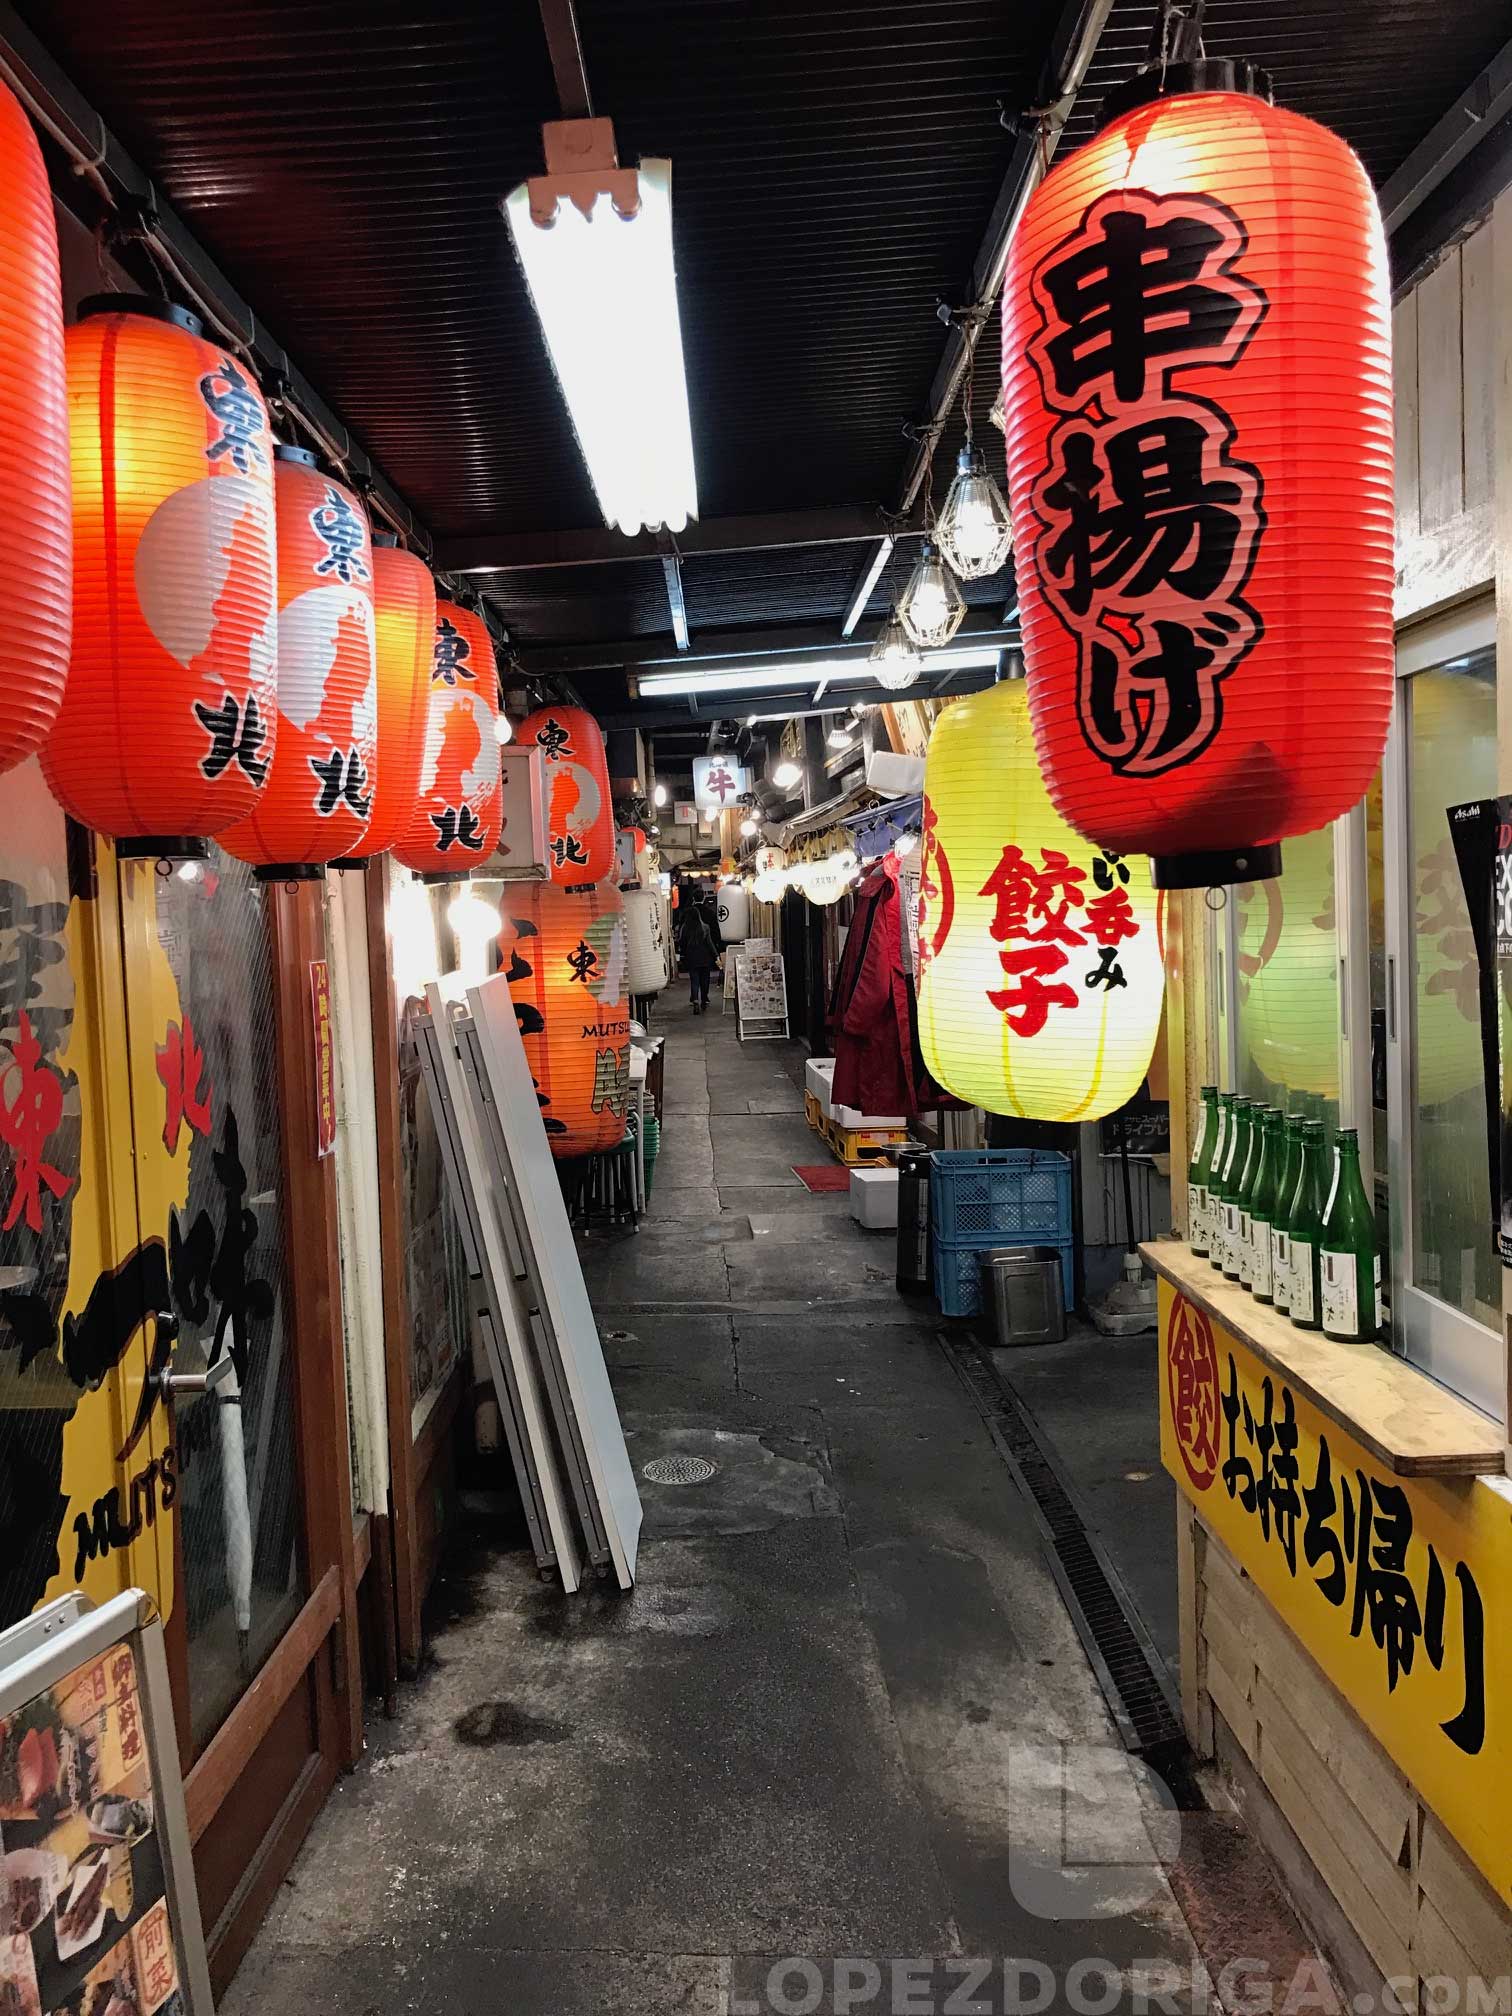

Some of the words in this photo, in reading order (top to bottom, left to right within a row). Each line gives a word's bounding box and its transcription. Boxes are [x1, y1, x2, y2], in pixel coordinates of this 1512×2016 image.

[1036, 203, 1258, 768] 串揚げ
[432, 617, 479, 685] 東
[536, 719, 575, 760] 東
[309, 745, 374, 820] 北
[706, 768, 736, 804] 牛
[429, 803, 488, 851] 北
[1454, 804, 1481, 820] Asahi
[566, 939, 600, 983] 東
[977, 844, 1089, 1038] 餃子
[1220, 1351, 1486, 1756] お持ち帰り
